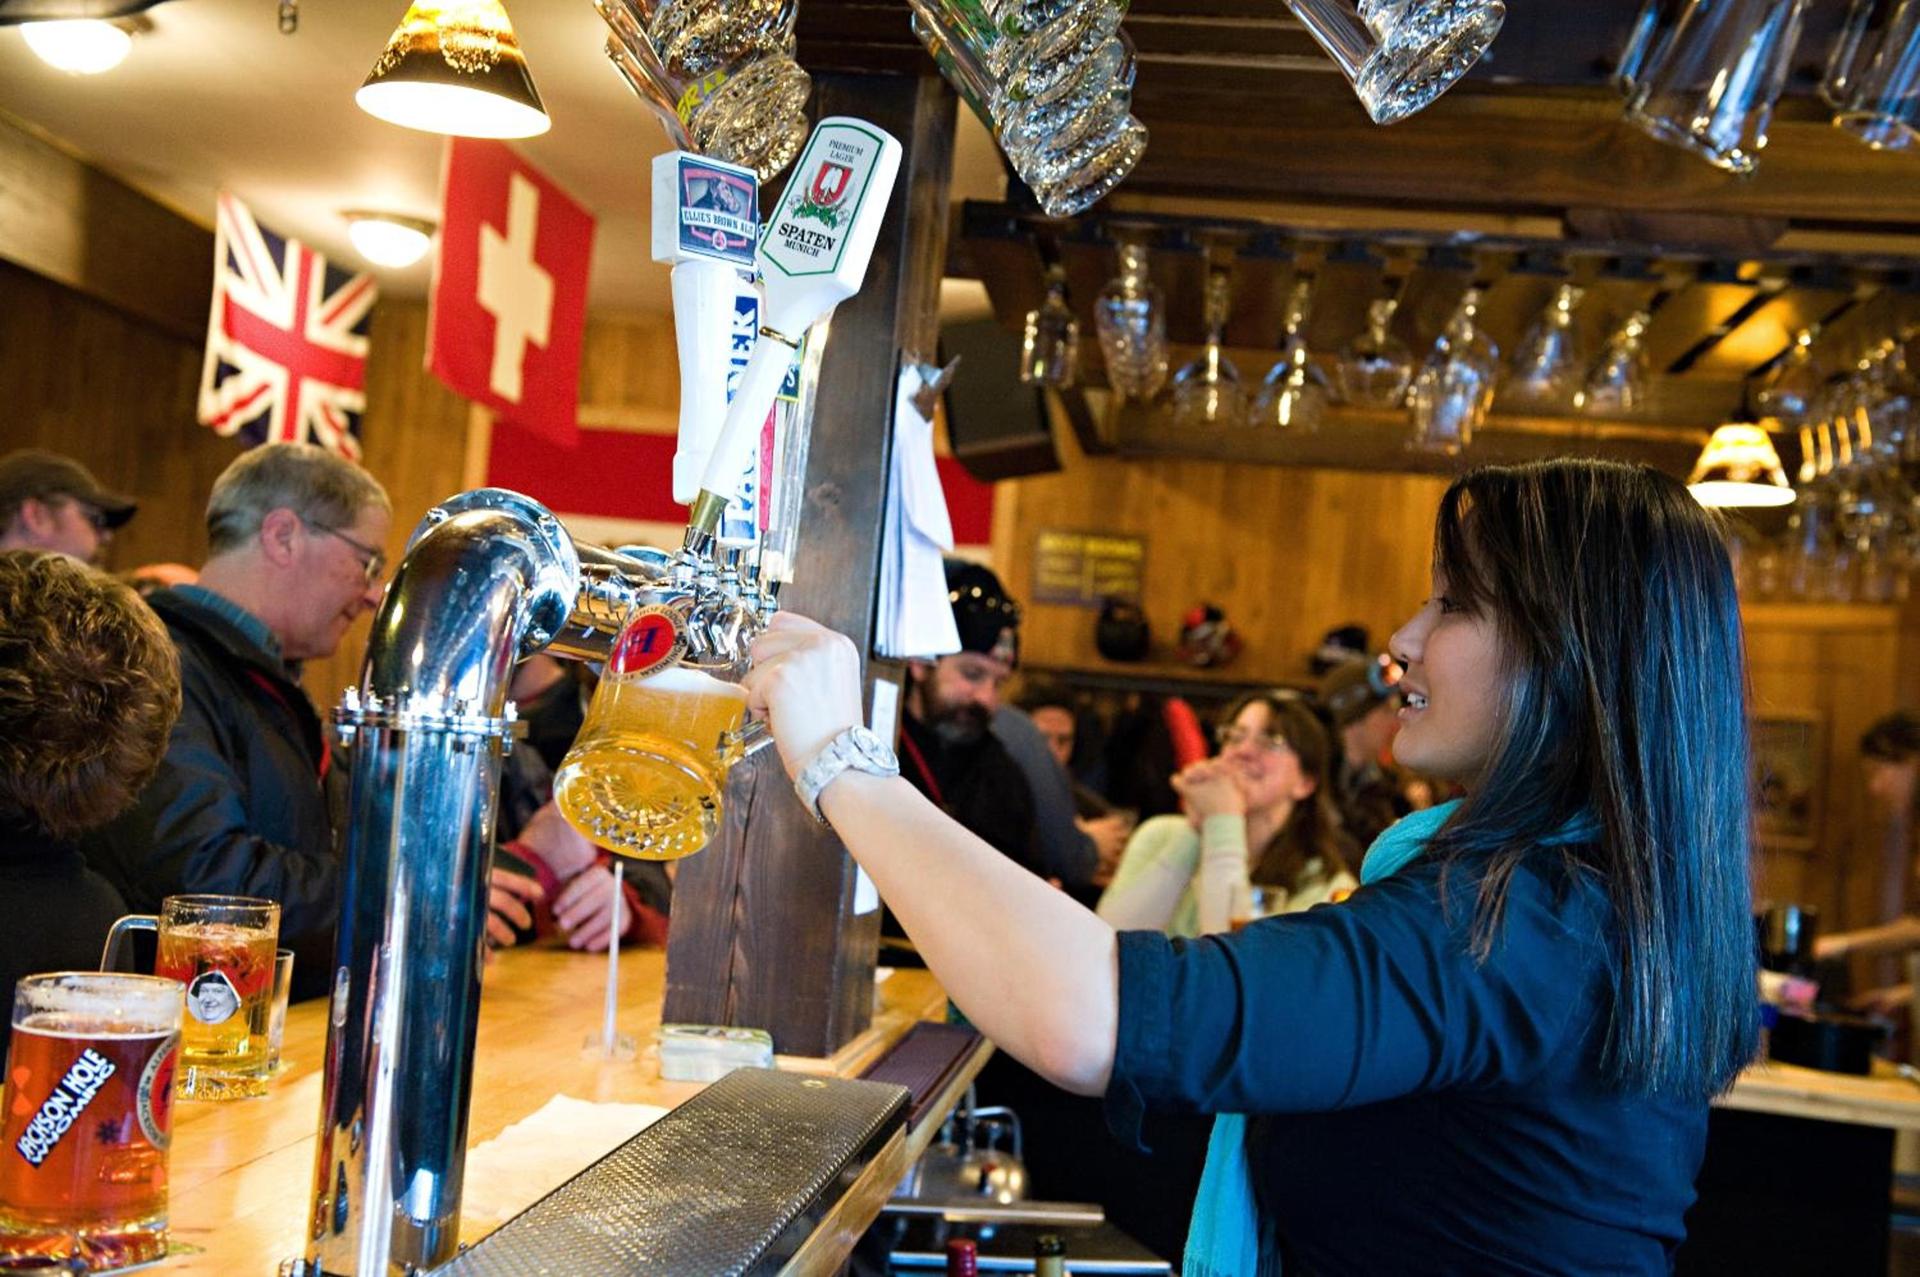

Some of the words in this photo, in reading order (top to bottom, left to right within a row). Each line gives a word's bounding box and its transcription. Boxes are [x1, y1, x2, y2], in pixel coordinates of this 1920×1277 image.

[828, 139, 864, 156] PREMIUM
[830, 150, 854, 163] LAGER
[684, 210, 711, 224] ELLIE'S
[714, 213, 738, 227] BROWN
[740, 221, 754, 235] ALE
[779, 222, 836, 251] SPATEN
[784, 239, 819, 258] MUNICH
[640, 644, 683, 677] WYOMING
[17, 1087, 74, 1160] JACKSON
[62, 1047, 107, 1095] HOLE
[31, 1063, 116, 1163] WYOMING
